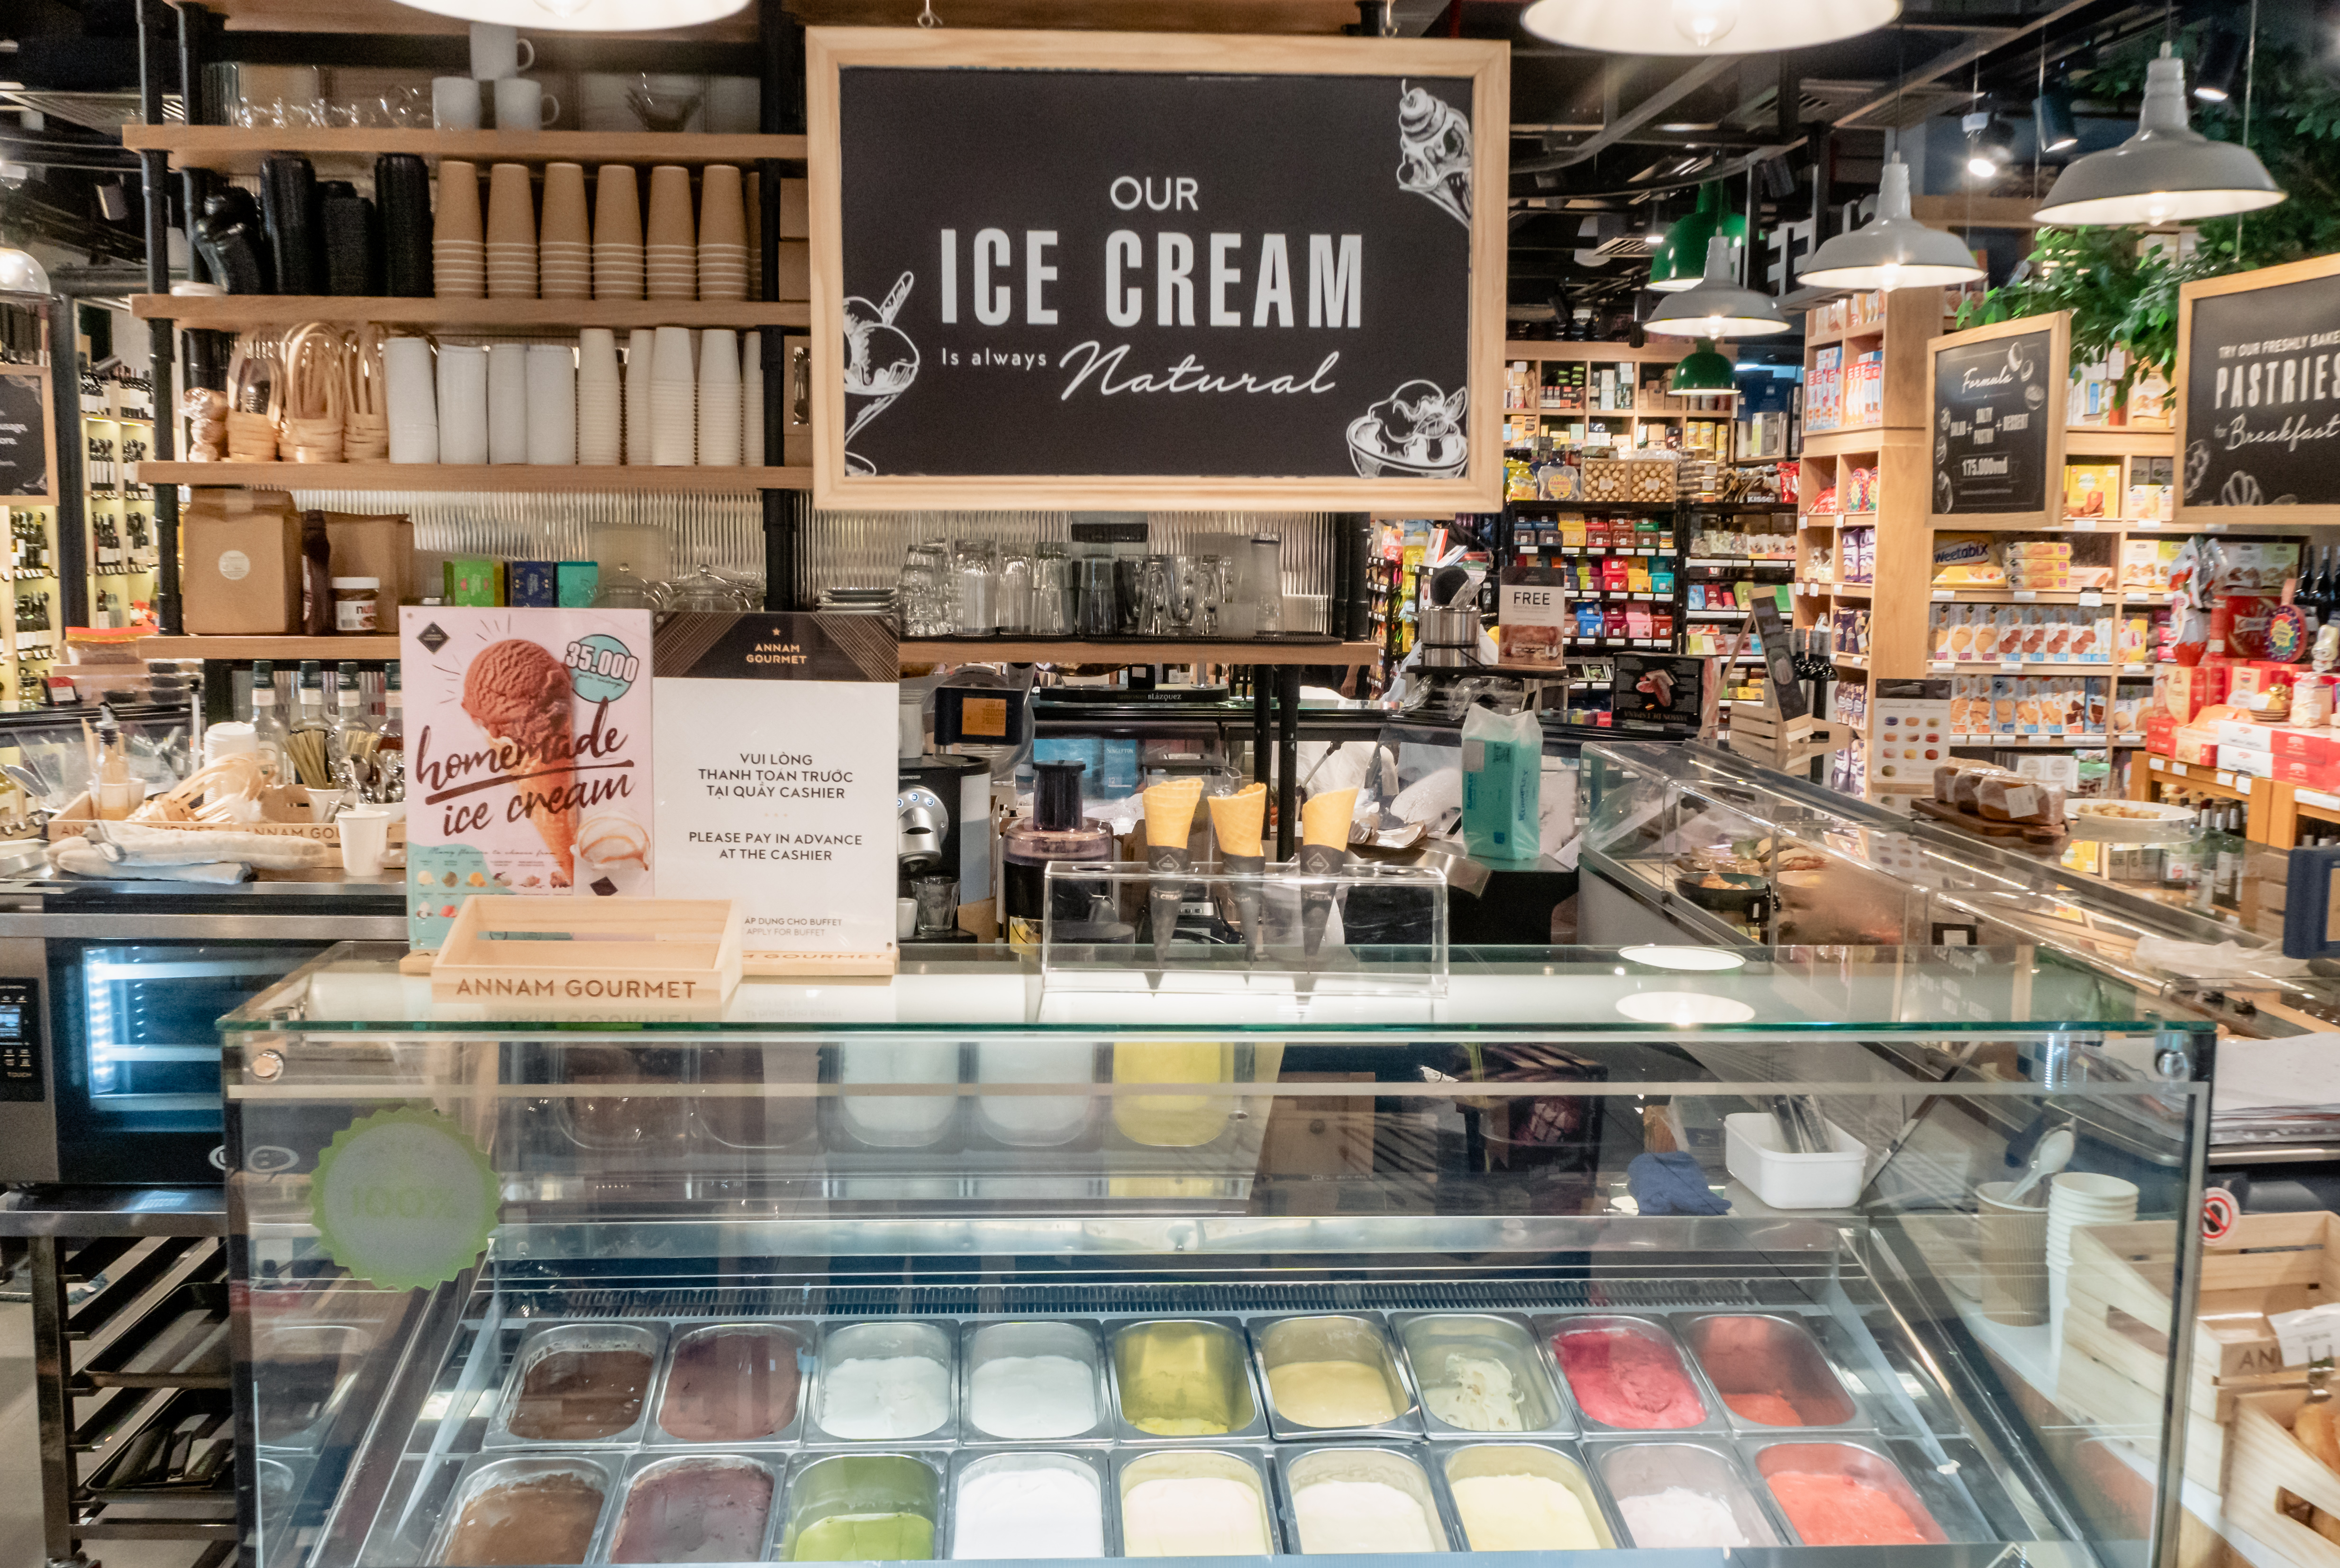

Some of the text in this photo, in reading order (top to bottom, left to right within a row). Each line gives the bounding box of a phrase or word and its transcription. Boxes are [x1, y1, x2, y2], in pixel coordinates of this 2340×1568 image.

[1110, 176, 1198, 211] OUR
[940, 228, 1362, 328] ICE CREAM
[2262, 335, 2308, 355] FRESHLY
[942, 340, 1339, 400] Is always Natural
[1962, 365, 2013, 394] Formula
[2225, 413, 2340, 452] Breakfast
[1514, 592, 1550, 605] FREE
[754, 643, 800, 653] ANNAM
[564, 641, 640, 684] 35.000
[746, 654, 807, 664] GOURMET
[415, 696, 628, 790] homemade
[740, 752, 813, 766] VUI LÒNG
[698, 768, 854, 783] THANH TOÁN TRƯỚC
[706, 781, 846, 799] TẠI QUẦY CASHIER
[443, 774, 636, 836] ice cream
[689, 832, 863, 845] PLEASE PAY IN ADVANCE
[719, 849, 832, 861] AT THE CASHIER
[745, 916, 756, 925] ÁP
[759, 918, 784, 926] DỤNG
[810, 918, 843, 926] BUFFET
[456, 978, 697, 999] ANNAM GOURMET
